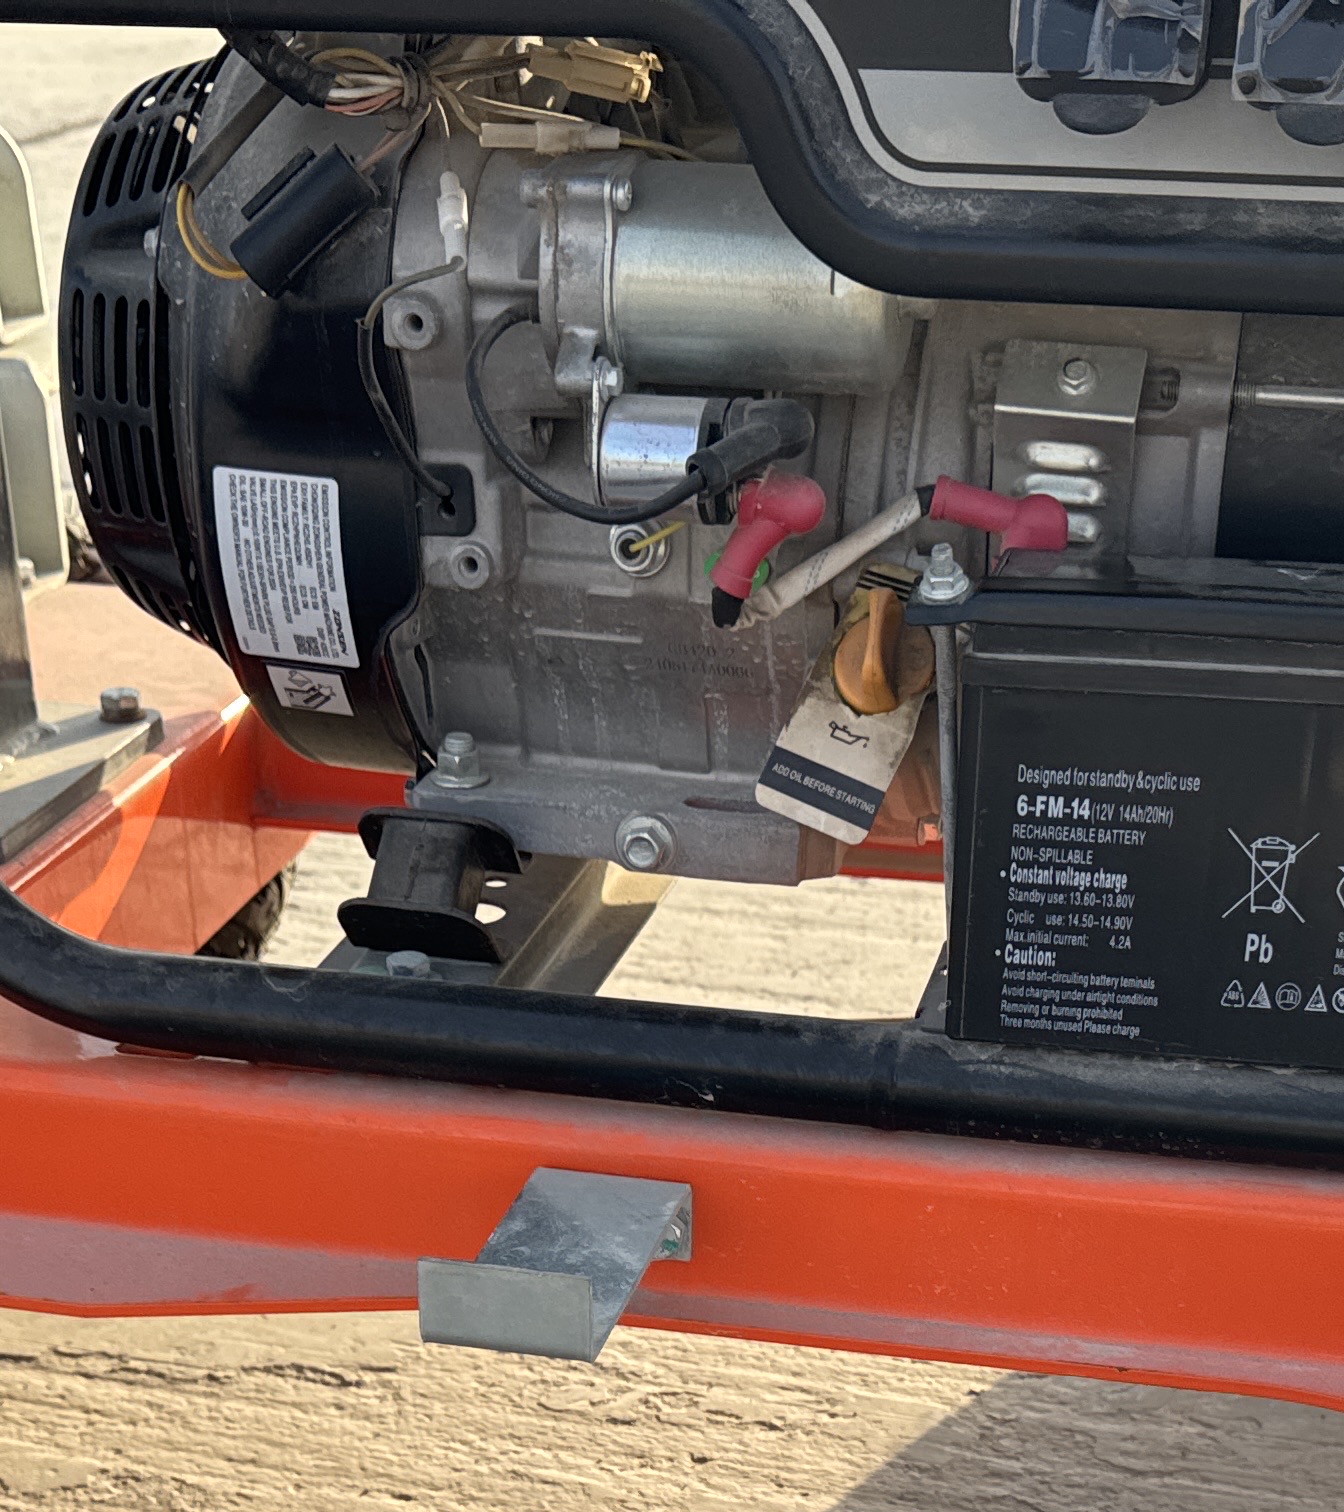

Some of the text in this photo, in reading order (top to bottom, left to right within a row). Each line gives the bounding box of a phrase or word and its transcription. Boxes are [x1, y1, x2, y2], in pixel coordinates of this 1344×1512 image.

[772, 762, 875, 814] ADD OIL BEFORE STARTING
[1018, 764, 1072, 788] Designed
[1180, 777, 1201, 791] use
[1017, 794, 1090, 820] 6-FM-14
[1119, 803, 1174, 829] 14Ah/20Hr)
[1012, 823, 1147, 846] RECHARGEABLE BATTERY
[1011, 845, 1094, 865] NON-SPILLABLE
[1010, 862, 1128, 893] Constant voltage charge
[1008, 887, 1046, 906] Standby
[1047, 893, 1068, 905] use:
[1006, 908, 1035, 924] Cyclic
[1045, 913, 1066, 926] use:
[1109, 935, 1132, 949] 4.2A
[1244, 933, 1273, 964] Pb
[1004, 943, 1056, 967] Caution:
[1002, 967, 1025, 981] Avoid
[1090, 973, 1119, 989] battery
[1001, 984, 1024, 997] Avoid
[1026, 987, 1059, 1003] charging
[1061, 989, 1085, 1001] under
[1116, 994, 1158, 1007] conditions
[1000, 1000, 1039, 1017] Removing
[1041, 1005, 1050, 1015] or
[1083, 1007, 1123, 1021] prohibited
[1000, 1014, 1140, 1039] Three months unused Please charge
